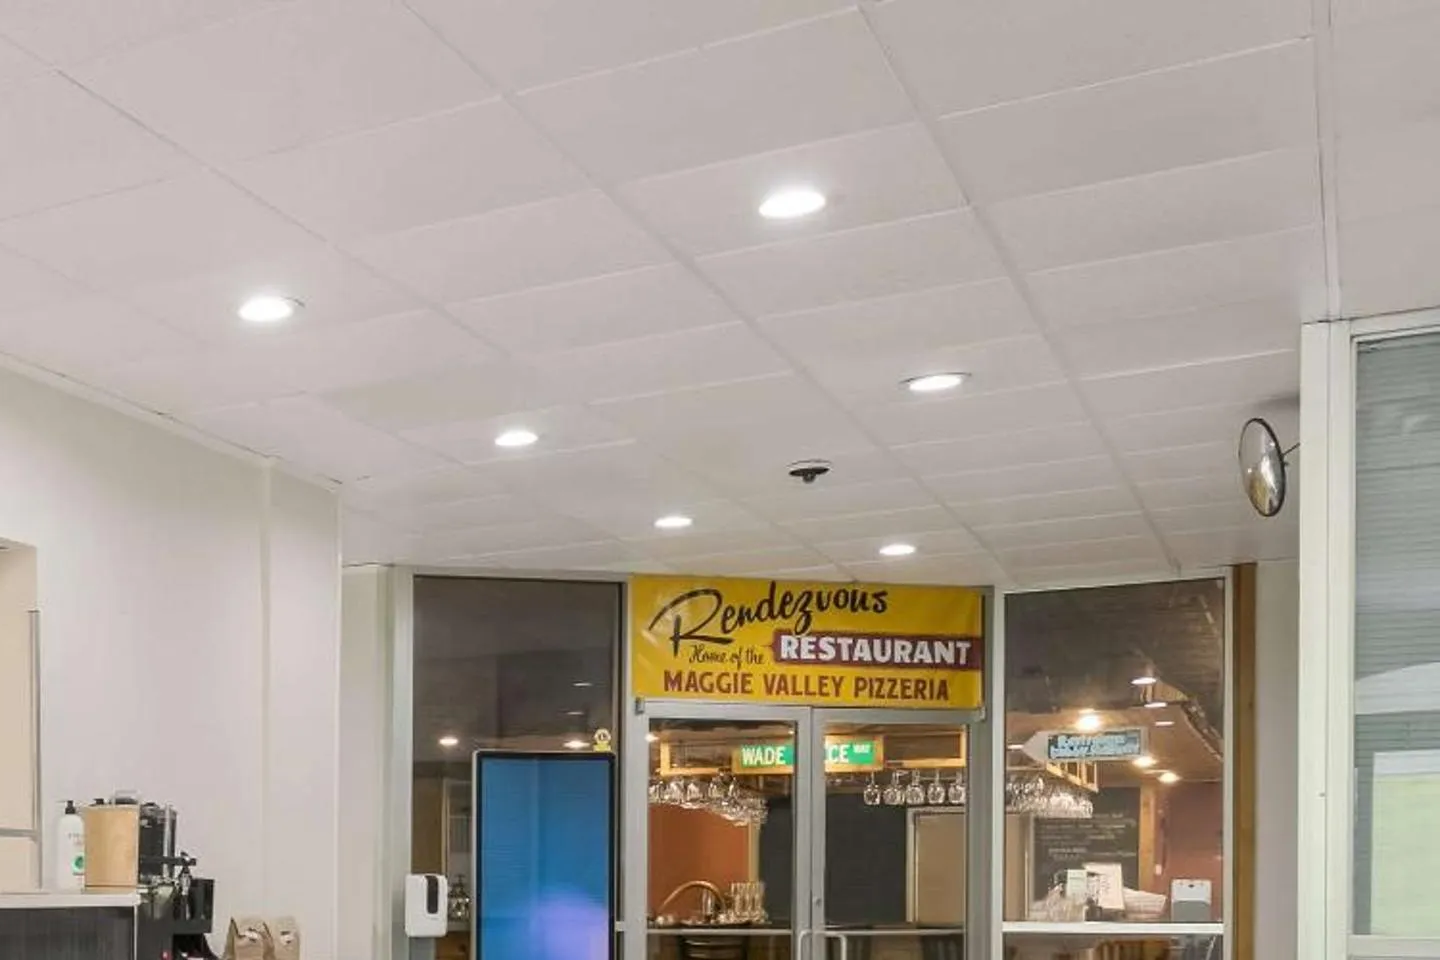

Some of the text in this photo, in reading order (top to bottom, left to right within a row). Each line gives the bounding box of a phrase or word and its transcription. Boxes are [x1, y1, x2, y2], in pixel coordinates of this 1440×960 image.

[648, 581, 888, 657] Rendezvous
[689, 644, 765, 670] Home of the
[780, 634, 972, 665] RESTAURANT
[663, 670, 949, 701] MAGGIE VALLEY PIZZERIA
[741, 746, 786, 765] WADE
